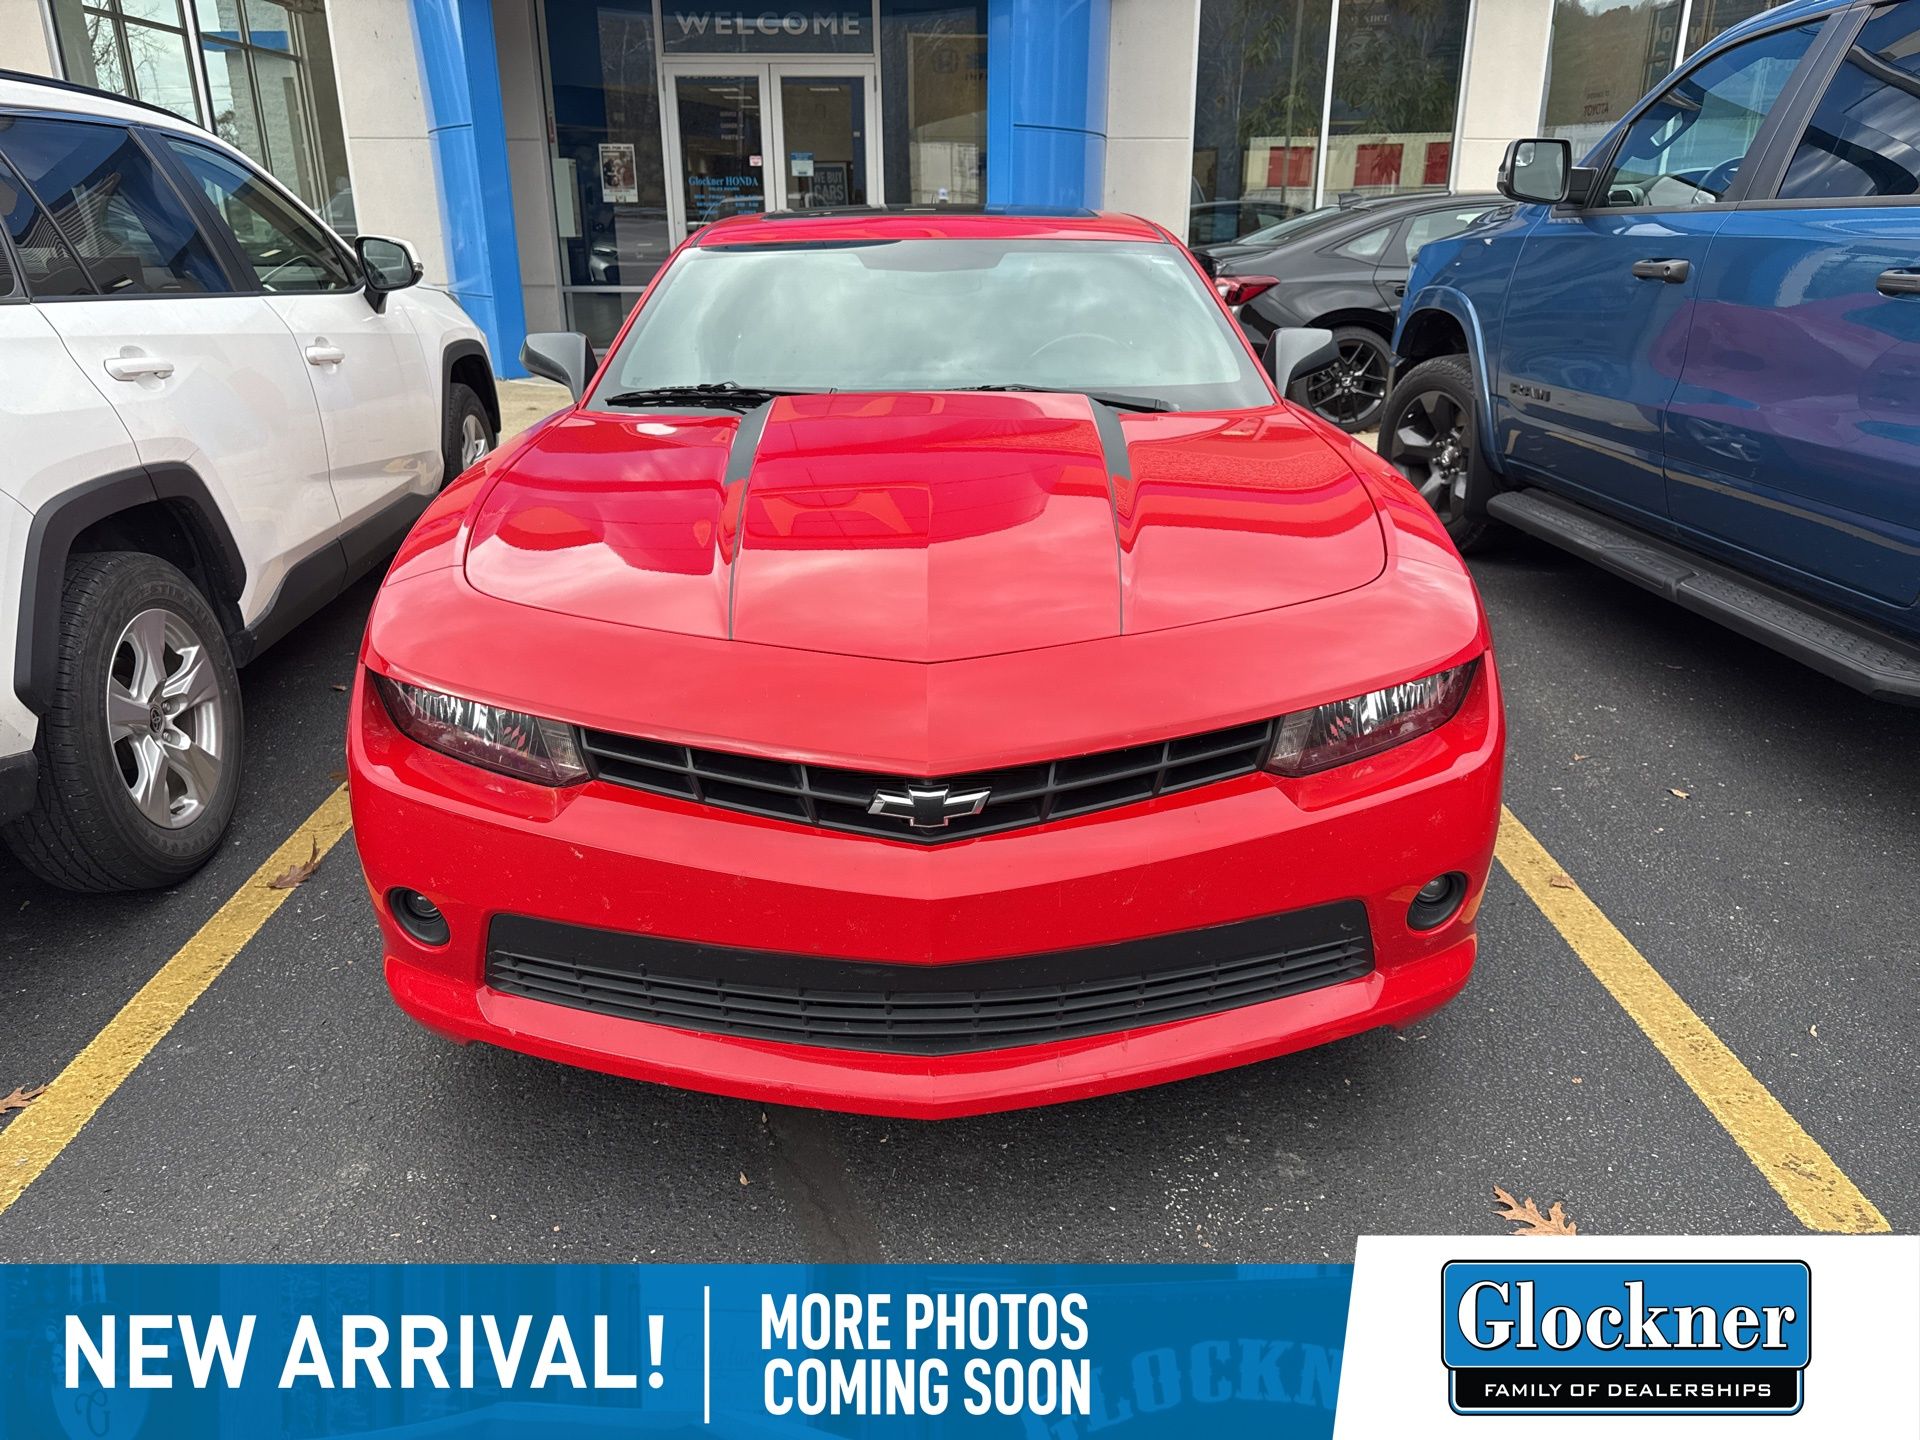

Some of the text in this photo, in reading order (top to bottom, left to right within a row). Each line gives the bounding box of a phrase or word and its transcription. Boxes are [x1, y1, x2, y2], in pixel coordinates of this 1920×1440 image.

[674, 11, 861, 36] WELCOME
[688, 175, 759, 187] Glockner HONDA
[826, 171, 843, 184] BUY
[814, 184, 844, 201] CARS
[1510, 383, 1551, 402] RAM
